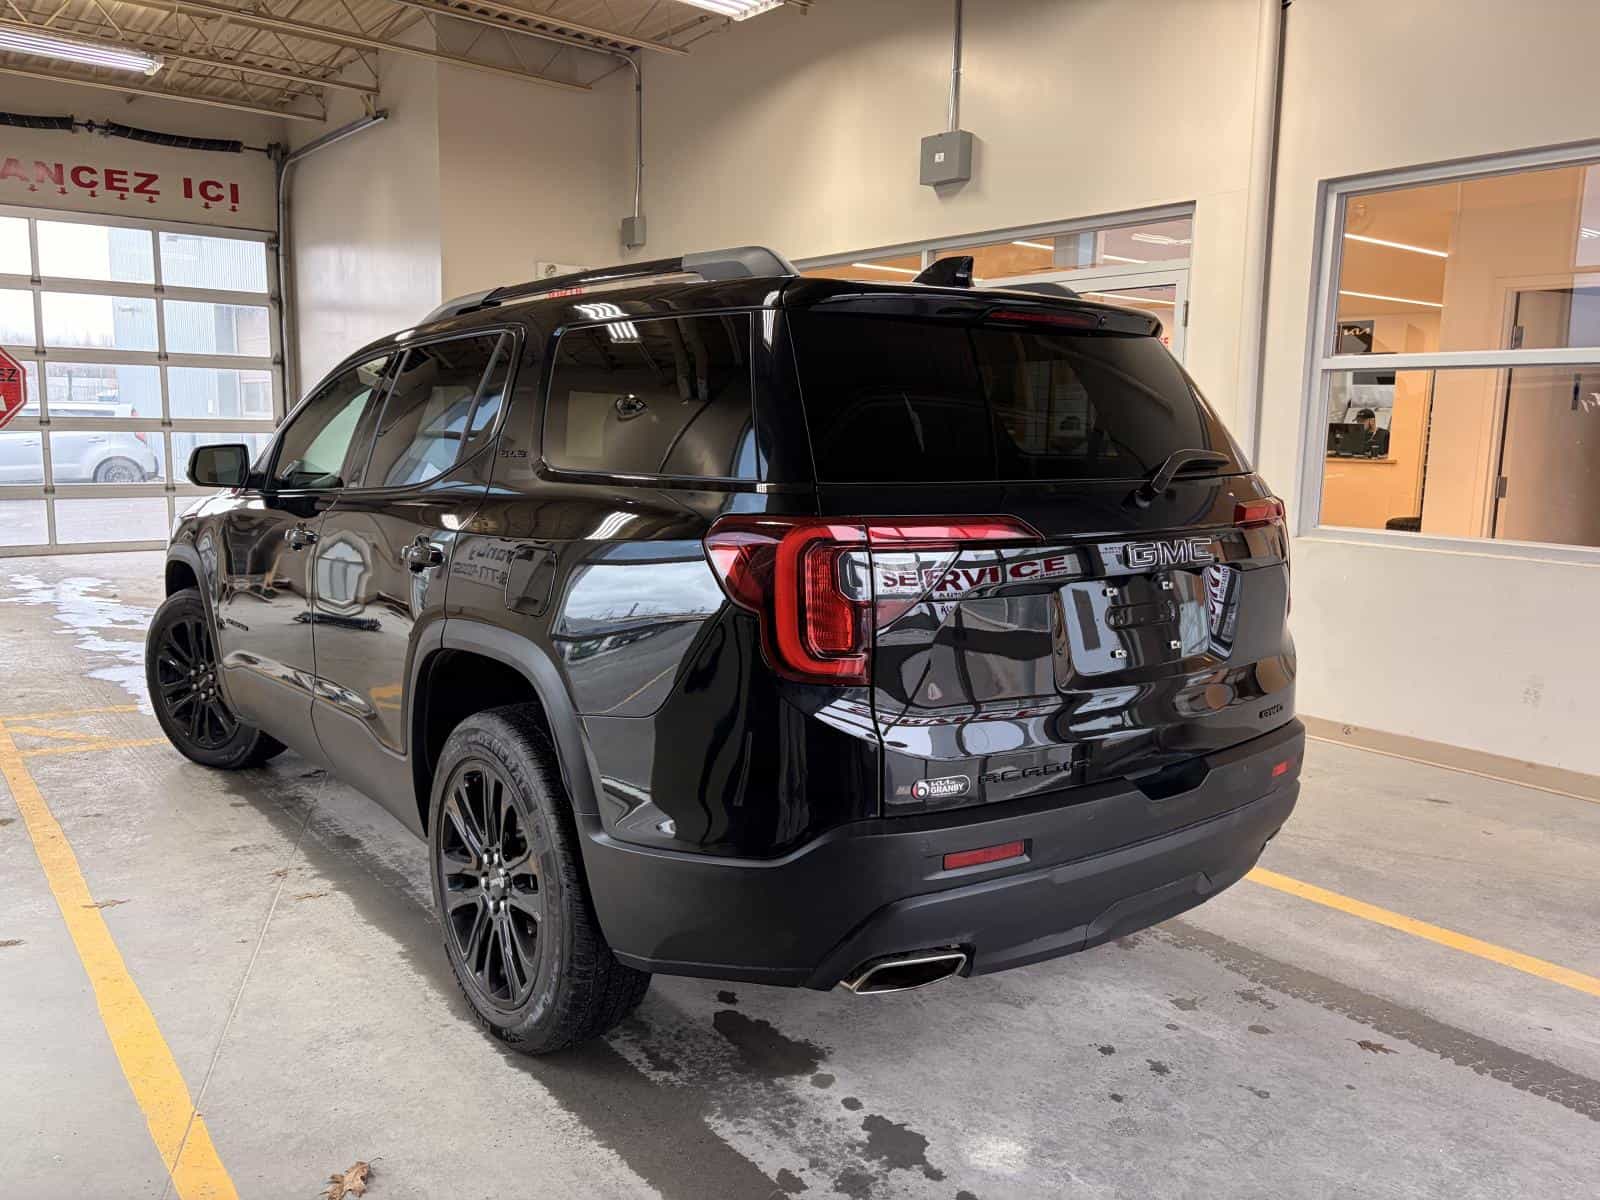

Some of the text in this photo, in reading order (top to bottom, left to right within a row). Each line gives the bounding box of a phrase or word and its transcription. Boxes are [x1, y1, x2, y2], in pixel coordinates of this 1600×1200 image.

[1127, 538, 1214, 568] GMC
[882, 556, 1068, 592] SERVICE
[930, 782, 966, 794] GRANBY
